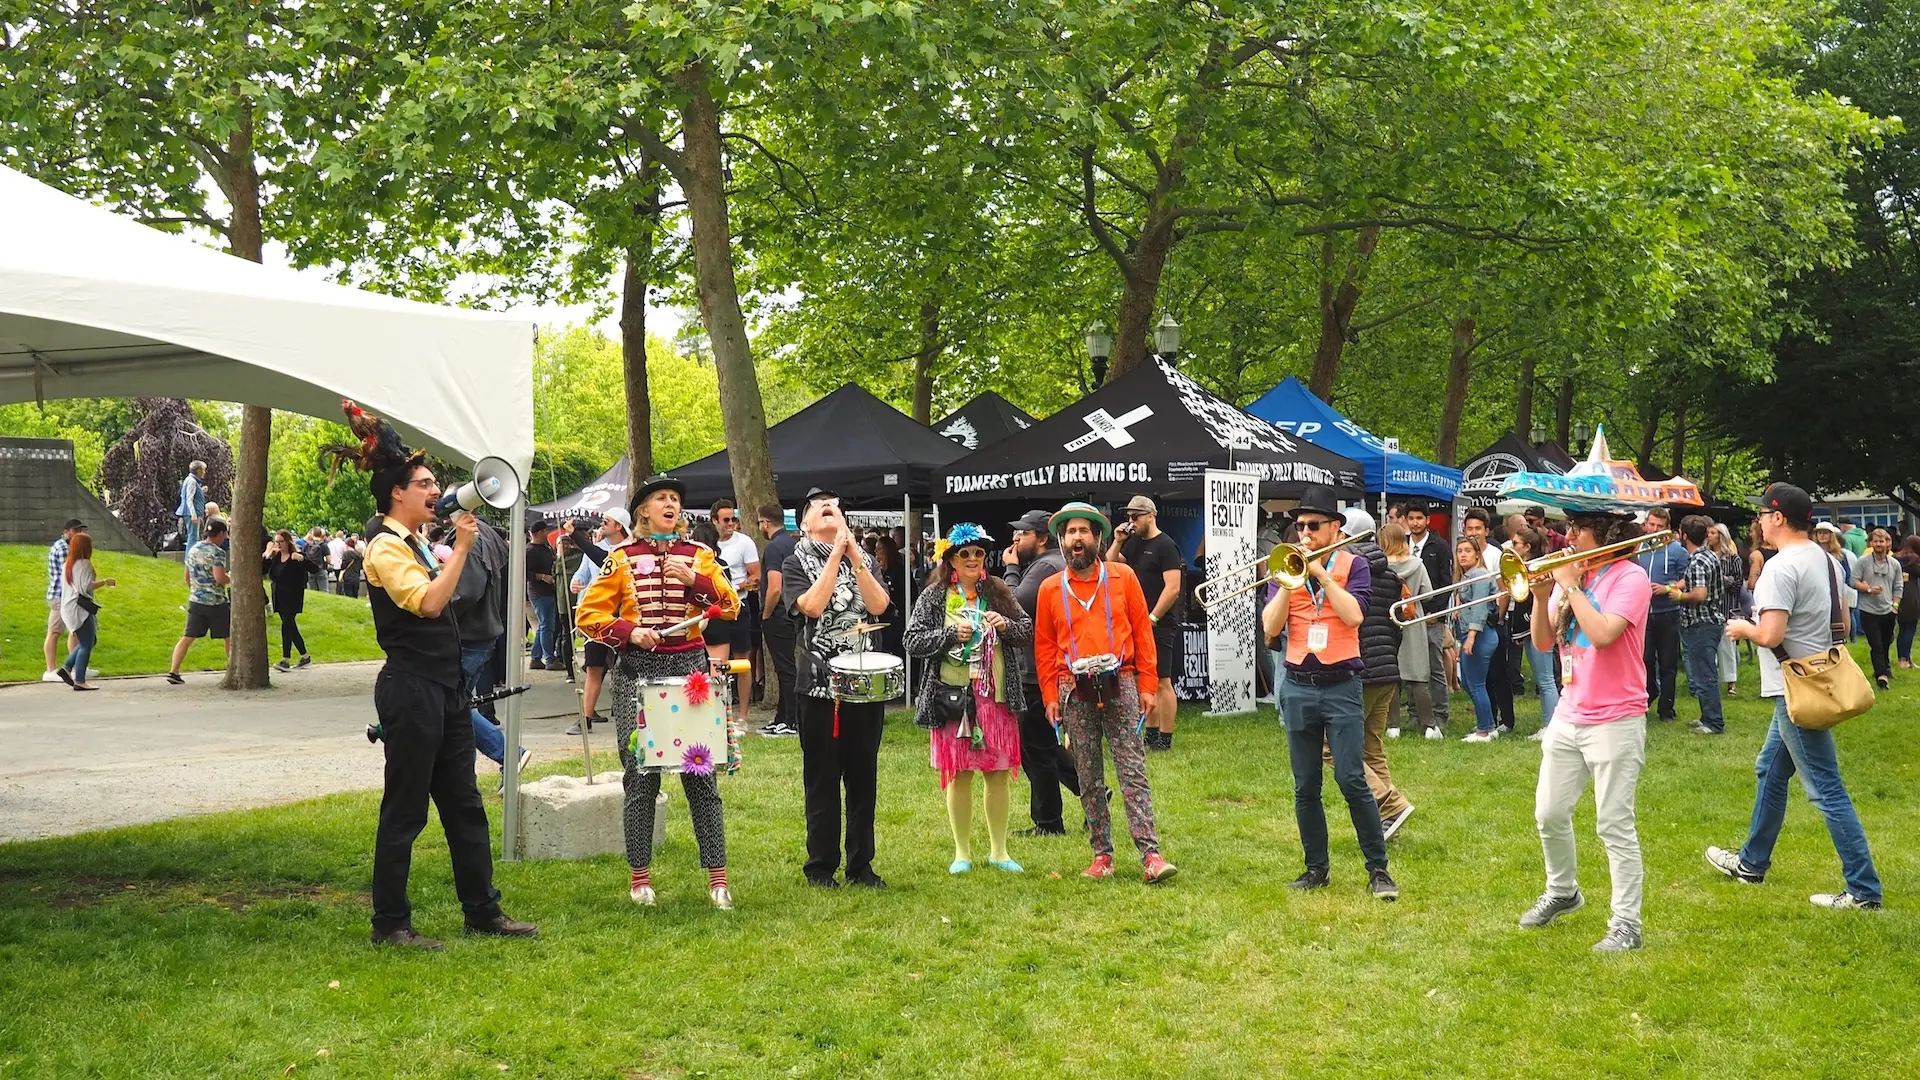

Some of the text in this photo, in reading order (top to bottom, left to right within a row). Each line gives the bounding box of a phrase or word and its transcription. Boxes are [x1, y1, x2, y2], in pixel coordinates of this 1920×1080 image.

[1070, 432, 1098, 448] FOLLY
[1235, 436, 1250, 445] 44
[1388, 442, 1398, 450] 45
[945, 474, 1013, 494] FOAMERS'
[1059, 462, 1125, 483] BREWING
[1128, 462, 1152, 482] CO.
[1392, 469, 1458, 492] CELEBRATE. EVERYDAY.
[581, 482, 628, 494] CATEGORY
[542, 508, 593, 519] CATEGORY
[1212, 504, 1244, 528] FOLLY
[1212, 528, 1228, 537] BREWING
[1184, 654, 1209, 678] FOLL
